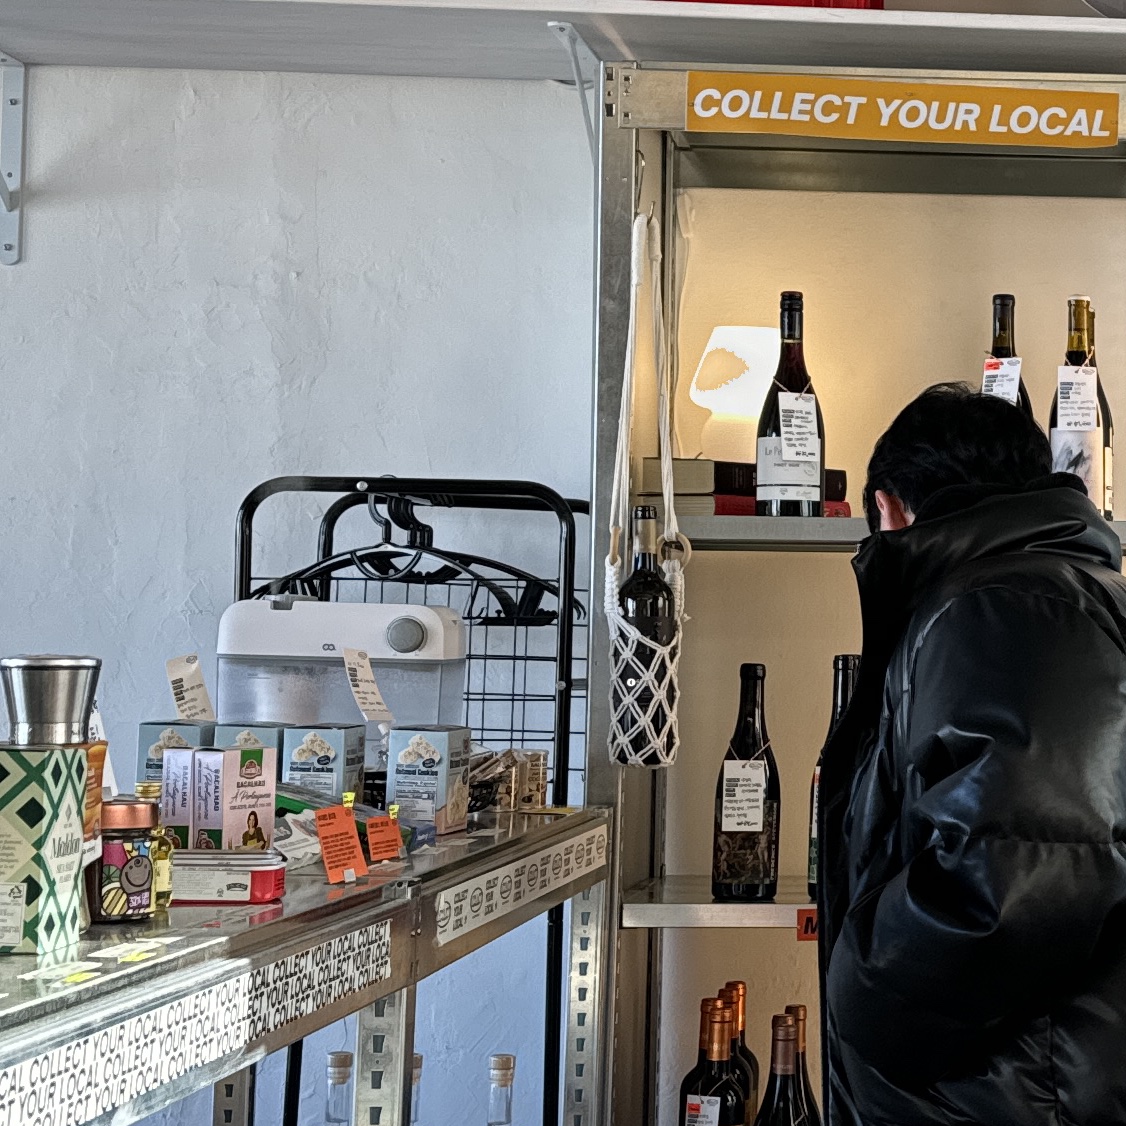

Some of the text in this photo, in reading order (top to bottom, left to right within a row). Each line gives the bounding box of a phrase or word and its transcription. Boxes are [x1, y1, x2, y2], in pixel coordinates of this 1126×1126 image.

[693, 88, 1111, 137] COLLECT YOUR LOCAL
[19, 1080, 56, 1123] YOUR
[59, 1062, 100, 1105] LOCAL
[103, 1038, 156, 1085] COLLECT
[159, 1025, 188, 1061] YOUR
[189, 1009, 221, 1047] LOCAL
[223, 989, 265, 1027] COLLECT
[267, 979, 290, 1012] YOUR
[290, 969, 315, 1001] LOCAL
[317, 954, 351, 987] COLLECT
[352, 947, 371, 972] YOUR
[29, 1039, 89, 1088] COLLECT
[94, 1024, 125, 1062] YOUR
[128, 1010, 163, 1048] LOCAL
[166, 989, 213, 1030] COLLECT
[216, 978, 241, 1007] YOUR
[242, 965, 270, 997] LOCAL
[273, 951, 310, 986] COLLECT
[312, 942, 332, 968] YOUR
[333, 932, 356, 960] LOCAL
[357, 920, 389, 949] COLLECT
[95, 1076, 128, 1116] YOUR
[130, 1060, 165, 1100] LOCAL
[168, 1037, 214, 1083] COLLECT
[216, 1025, 242, 1058] YOUR
[244, 1014, 271, 1047] LOCAL
[273, 993, 311, 1032] COLLECT
[312, 984, 332, 1012] YOUR
